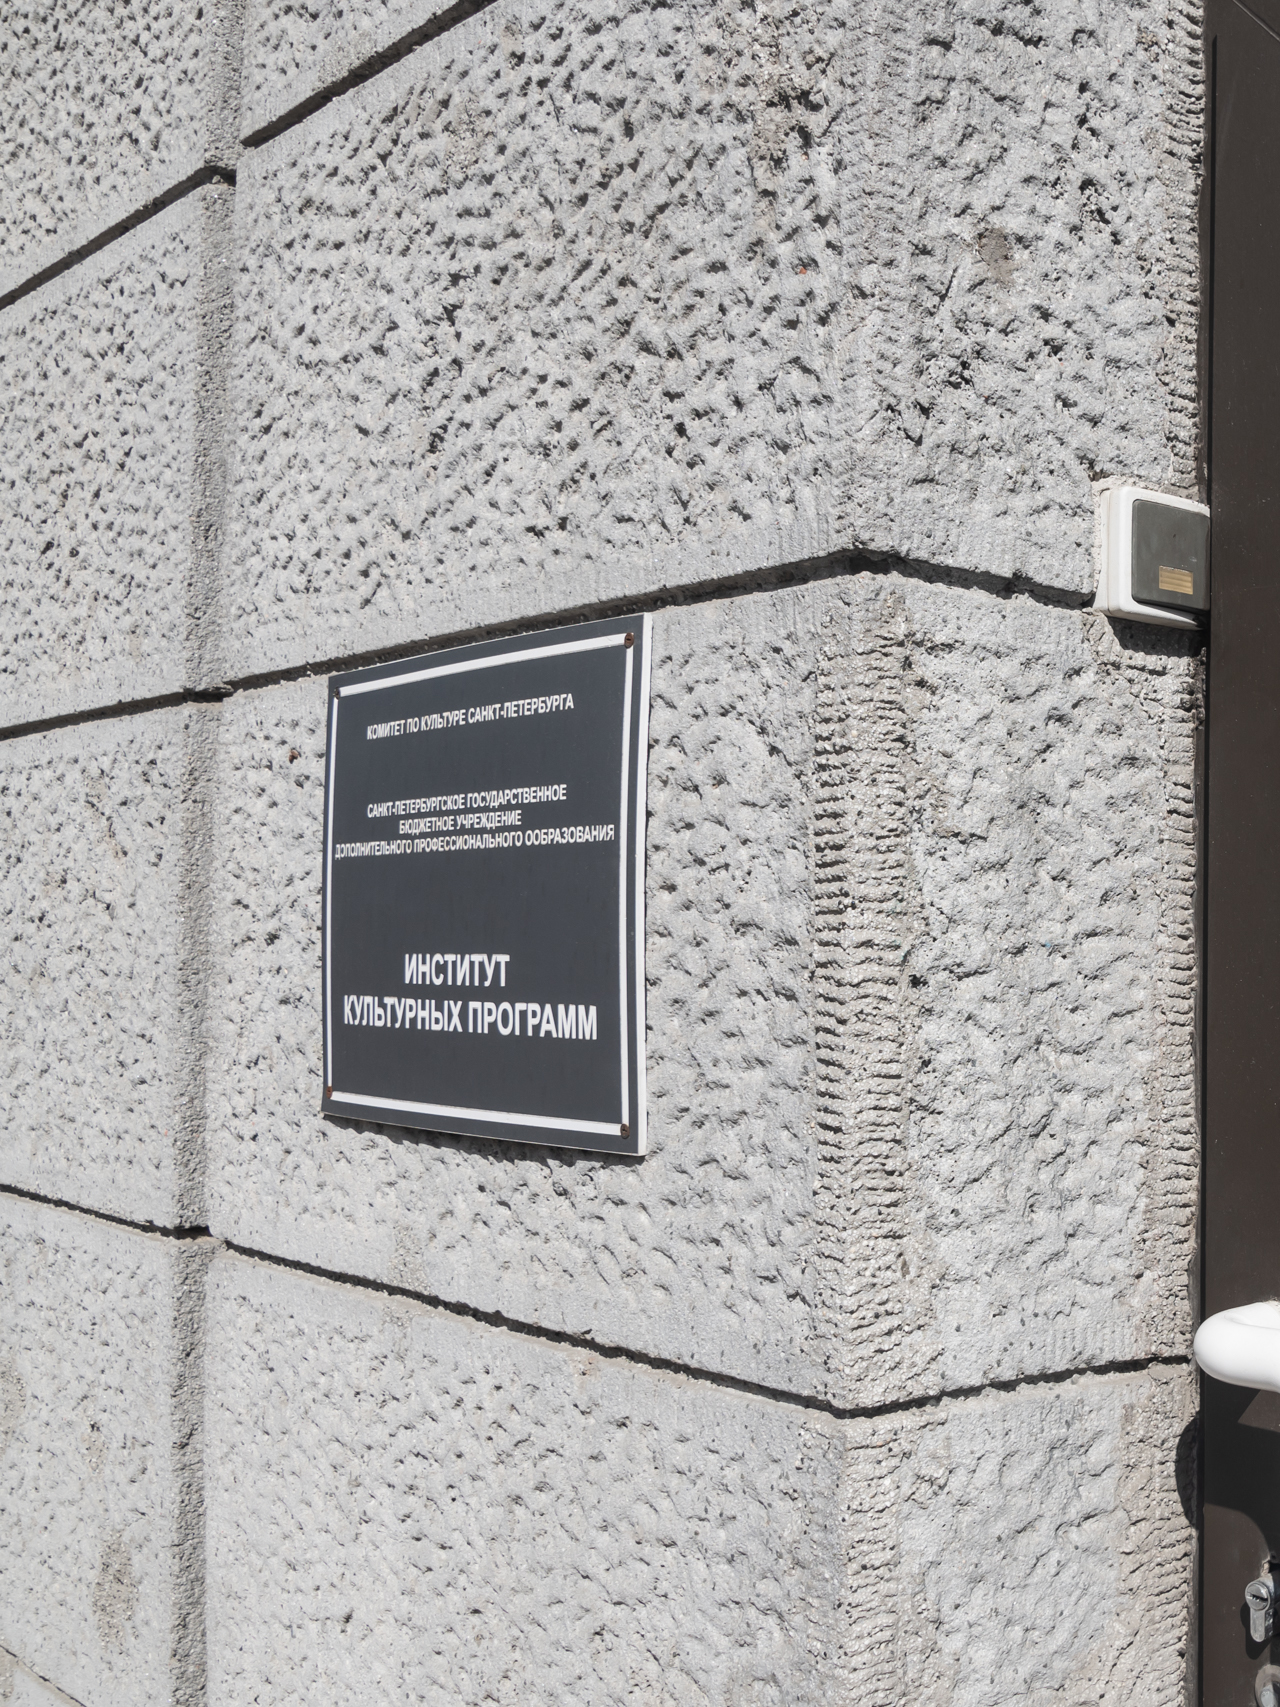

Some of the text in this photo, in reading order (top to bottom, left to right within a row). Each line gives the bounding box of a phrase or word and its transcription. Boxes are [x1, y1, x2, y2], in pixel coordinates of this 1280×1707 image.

[367, 693, 574, 740] КОМИТЕТ ПО КУЛЬТУРЕ САНКТ-ПЕТЕРБУРГА
[367, 784, 567, 818] САНКТ-ПЕТЕРБУРГСКОЕ ГОСУДАРСТВЕННОЕ
[399, 810, 522, 836] БЮДЖЕТНОЕ УЧРЕЖДЕНИЕ
[335, 824, 615, 860] ДОПОЛНИТЕЛЬНОГО ПРОФЕССИОНАЛЬНОГО ООБРАЗОВАНИЯ
[404, 953, 510, 987] ИНСТИТУТ
[344, 995, 597, 1040] КУЛЬТУРНЫХ ПРОГРАММ
